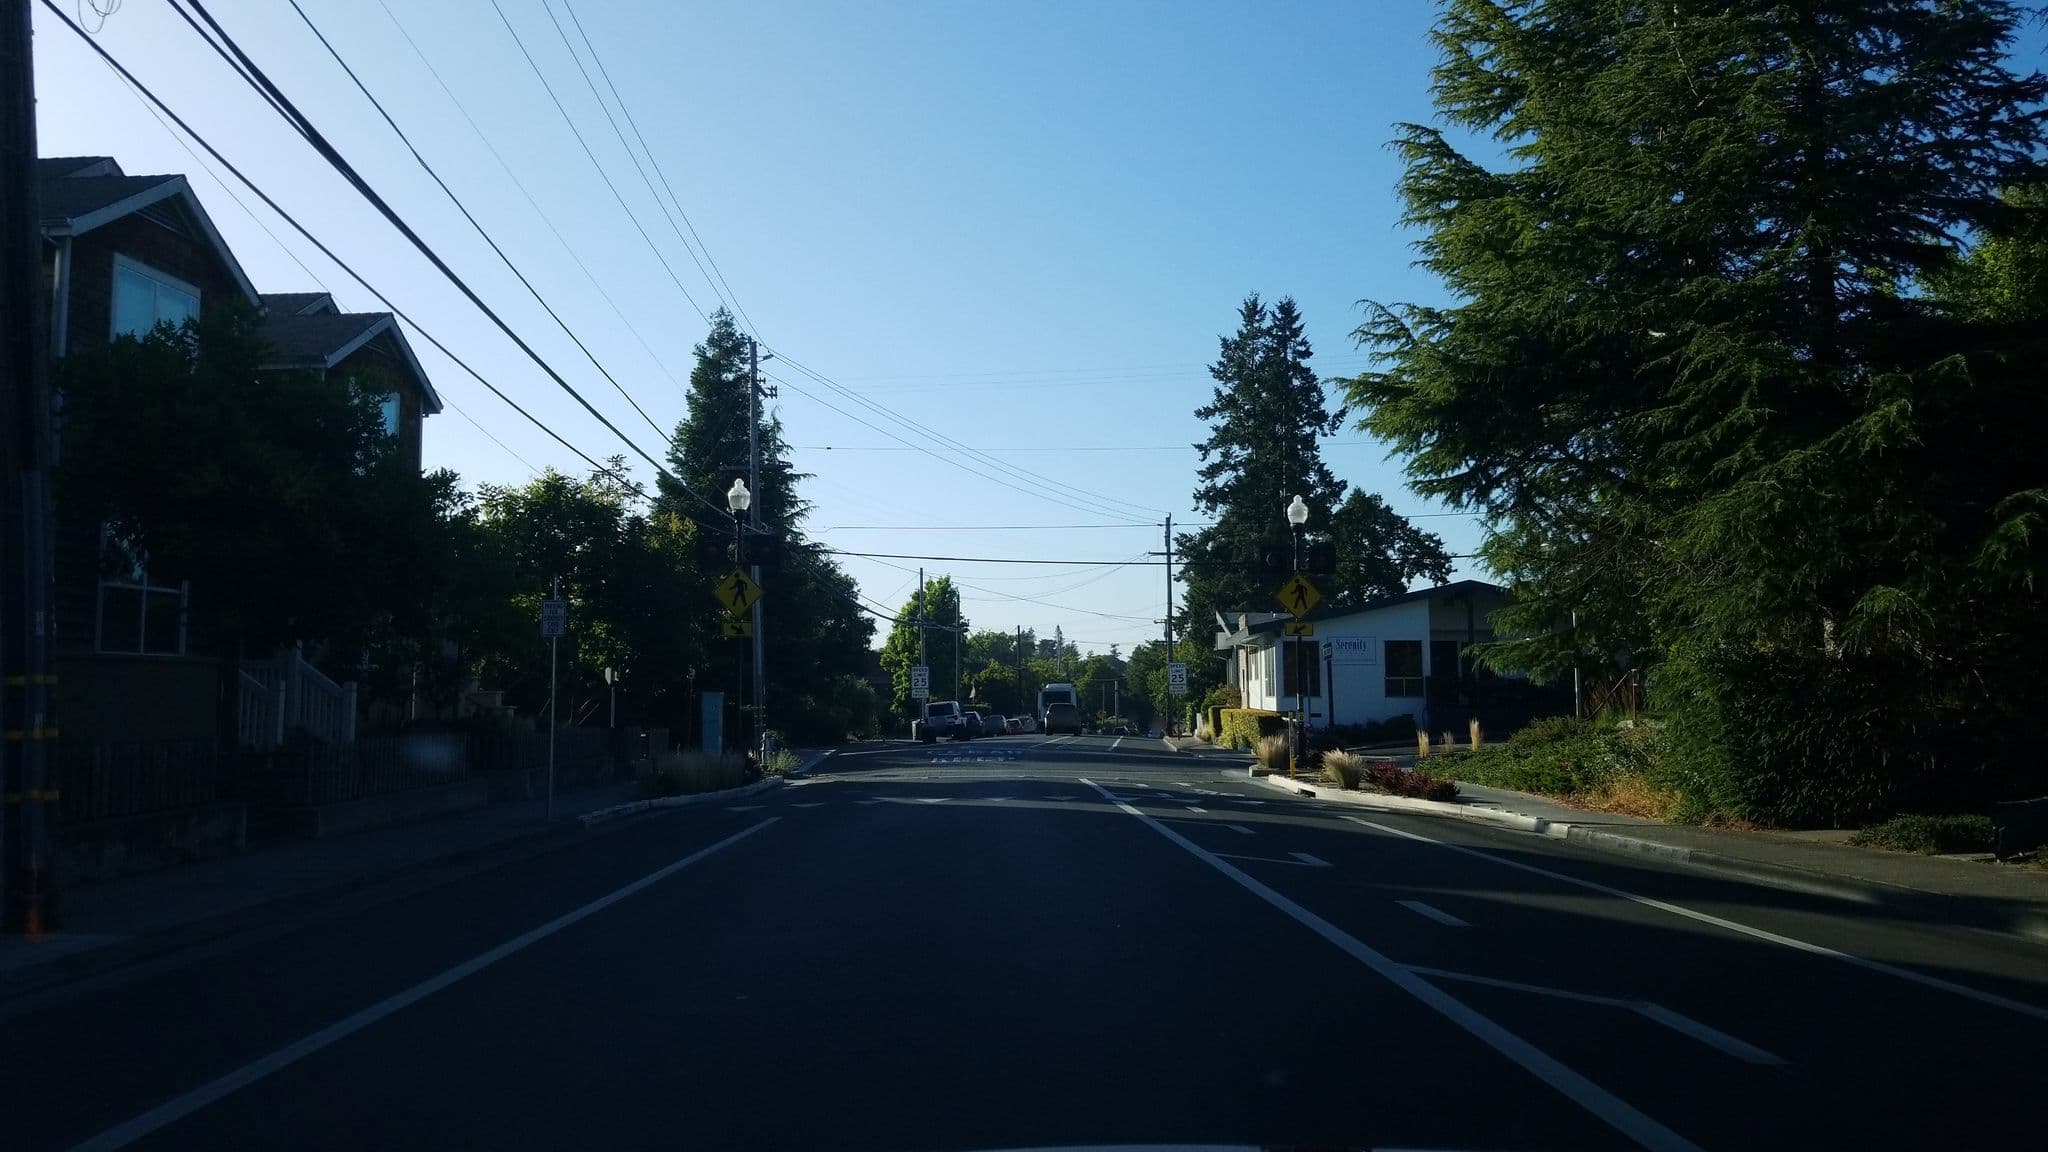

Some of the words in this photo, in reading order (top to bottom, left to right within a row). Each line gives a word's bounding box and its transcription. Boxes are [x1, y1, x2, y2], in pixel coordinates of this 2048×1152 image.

[1335, 638, 1366, 651] Serenity
[913, 678, 927, 686] 25
[1171, 674, 1184, 682] 25
